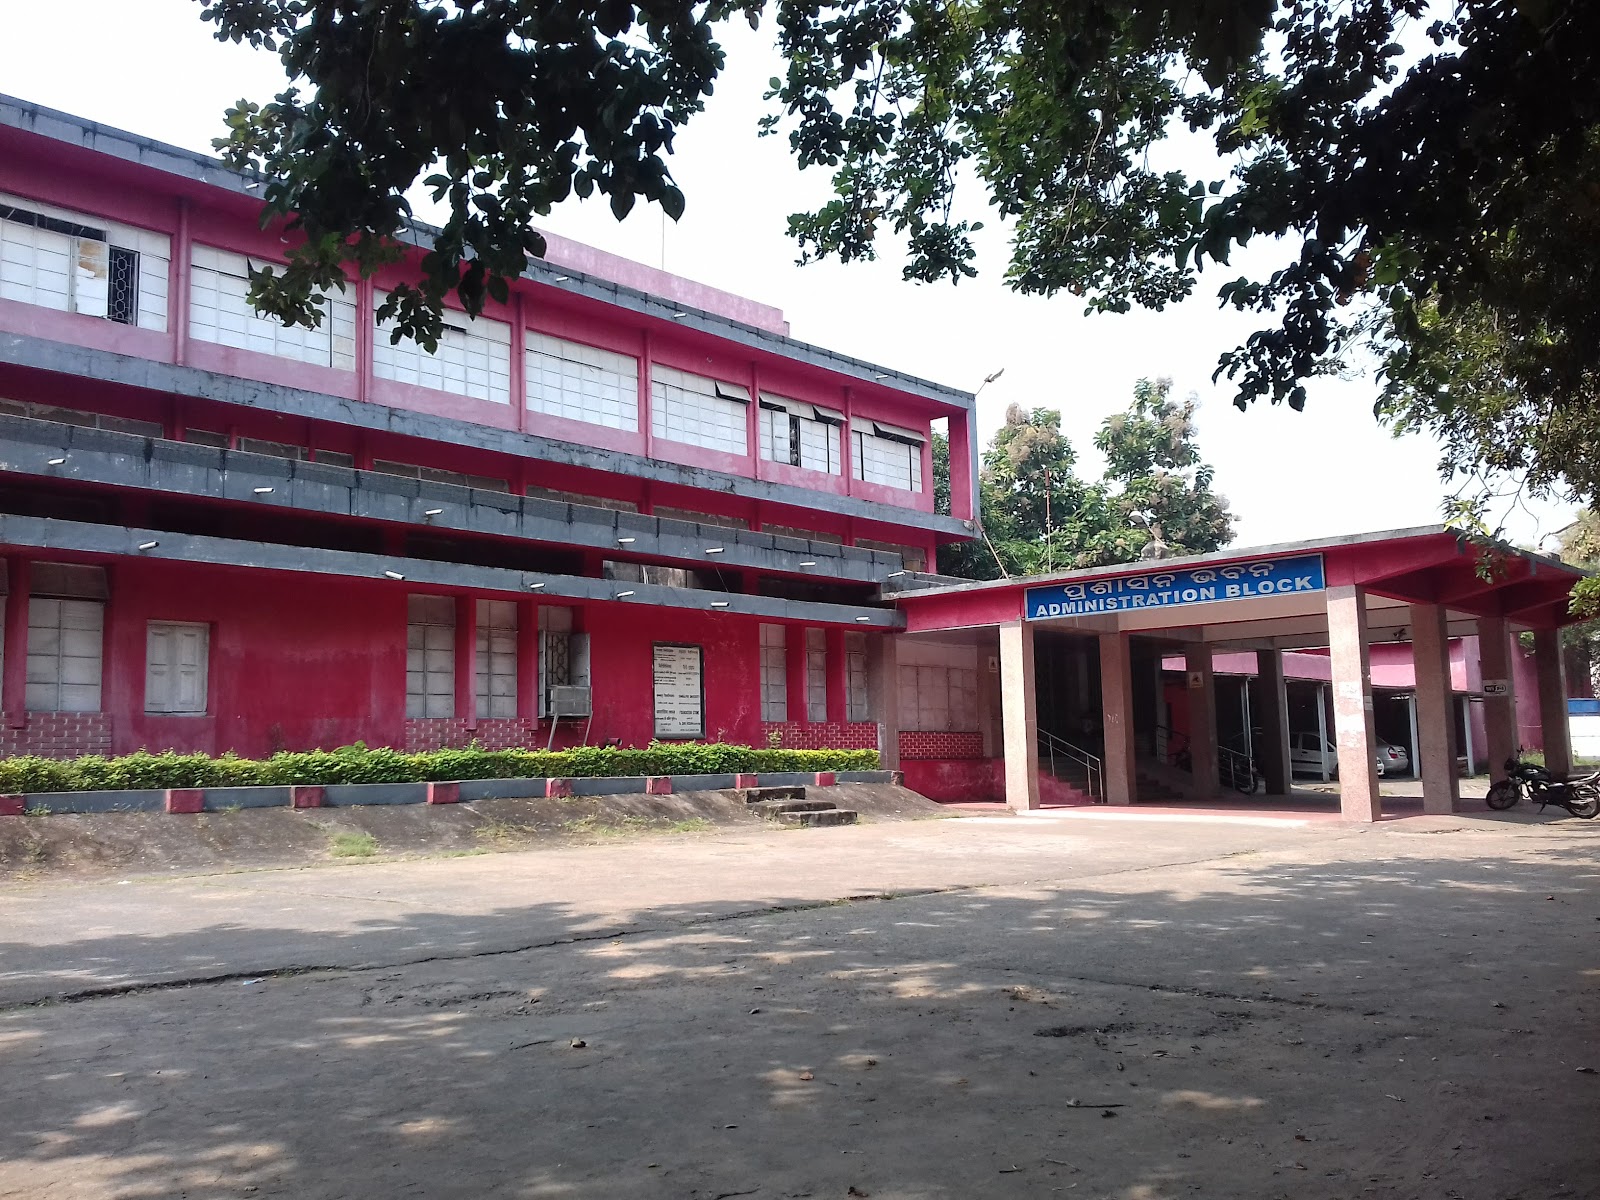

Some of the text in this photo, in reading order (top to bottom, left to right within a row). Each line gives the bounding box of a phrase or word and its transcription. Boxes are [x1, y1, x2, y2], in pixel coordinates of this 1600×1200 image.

[1036, 576, 1313, 617] ADMINISTRATION BLOCK
[1064, 563, 1274, 600] ପ୍ରଶାସନ ଭବନ
